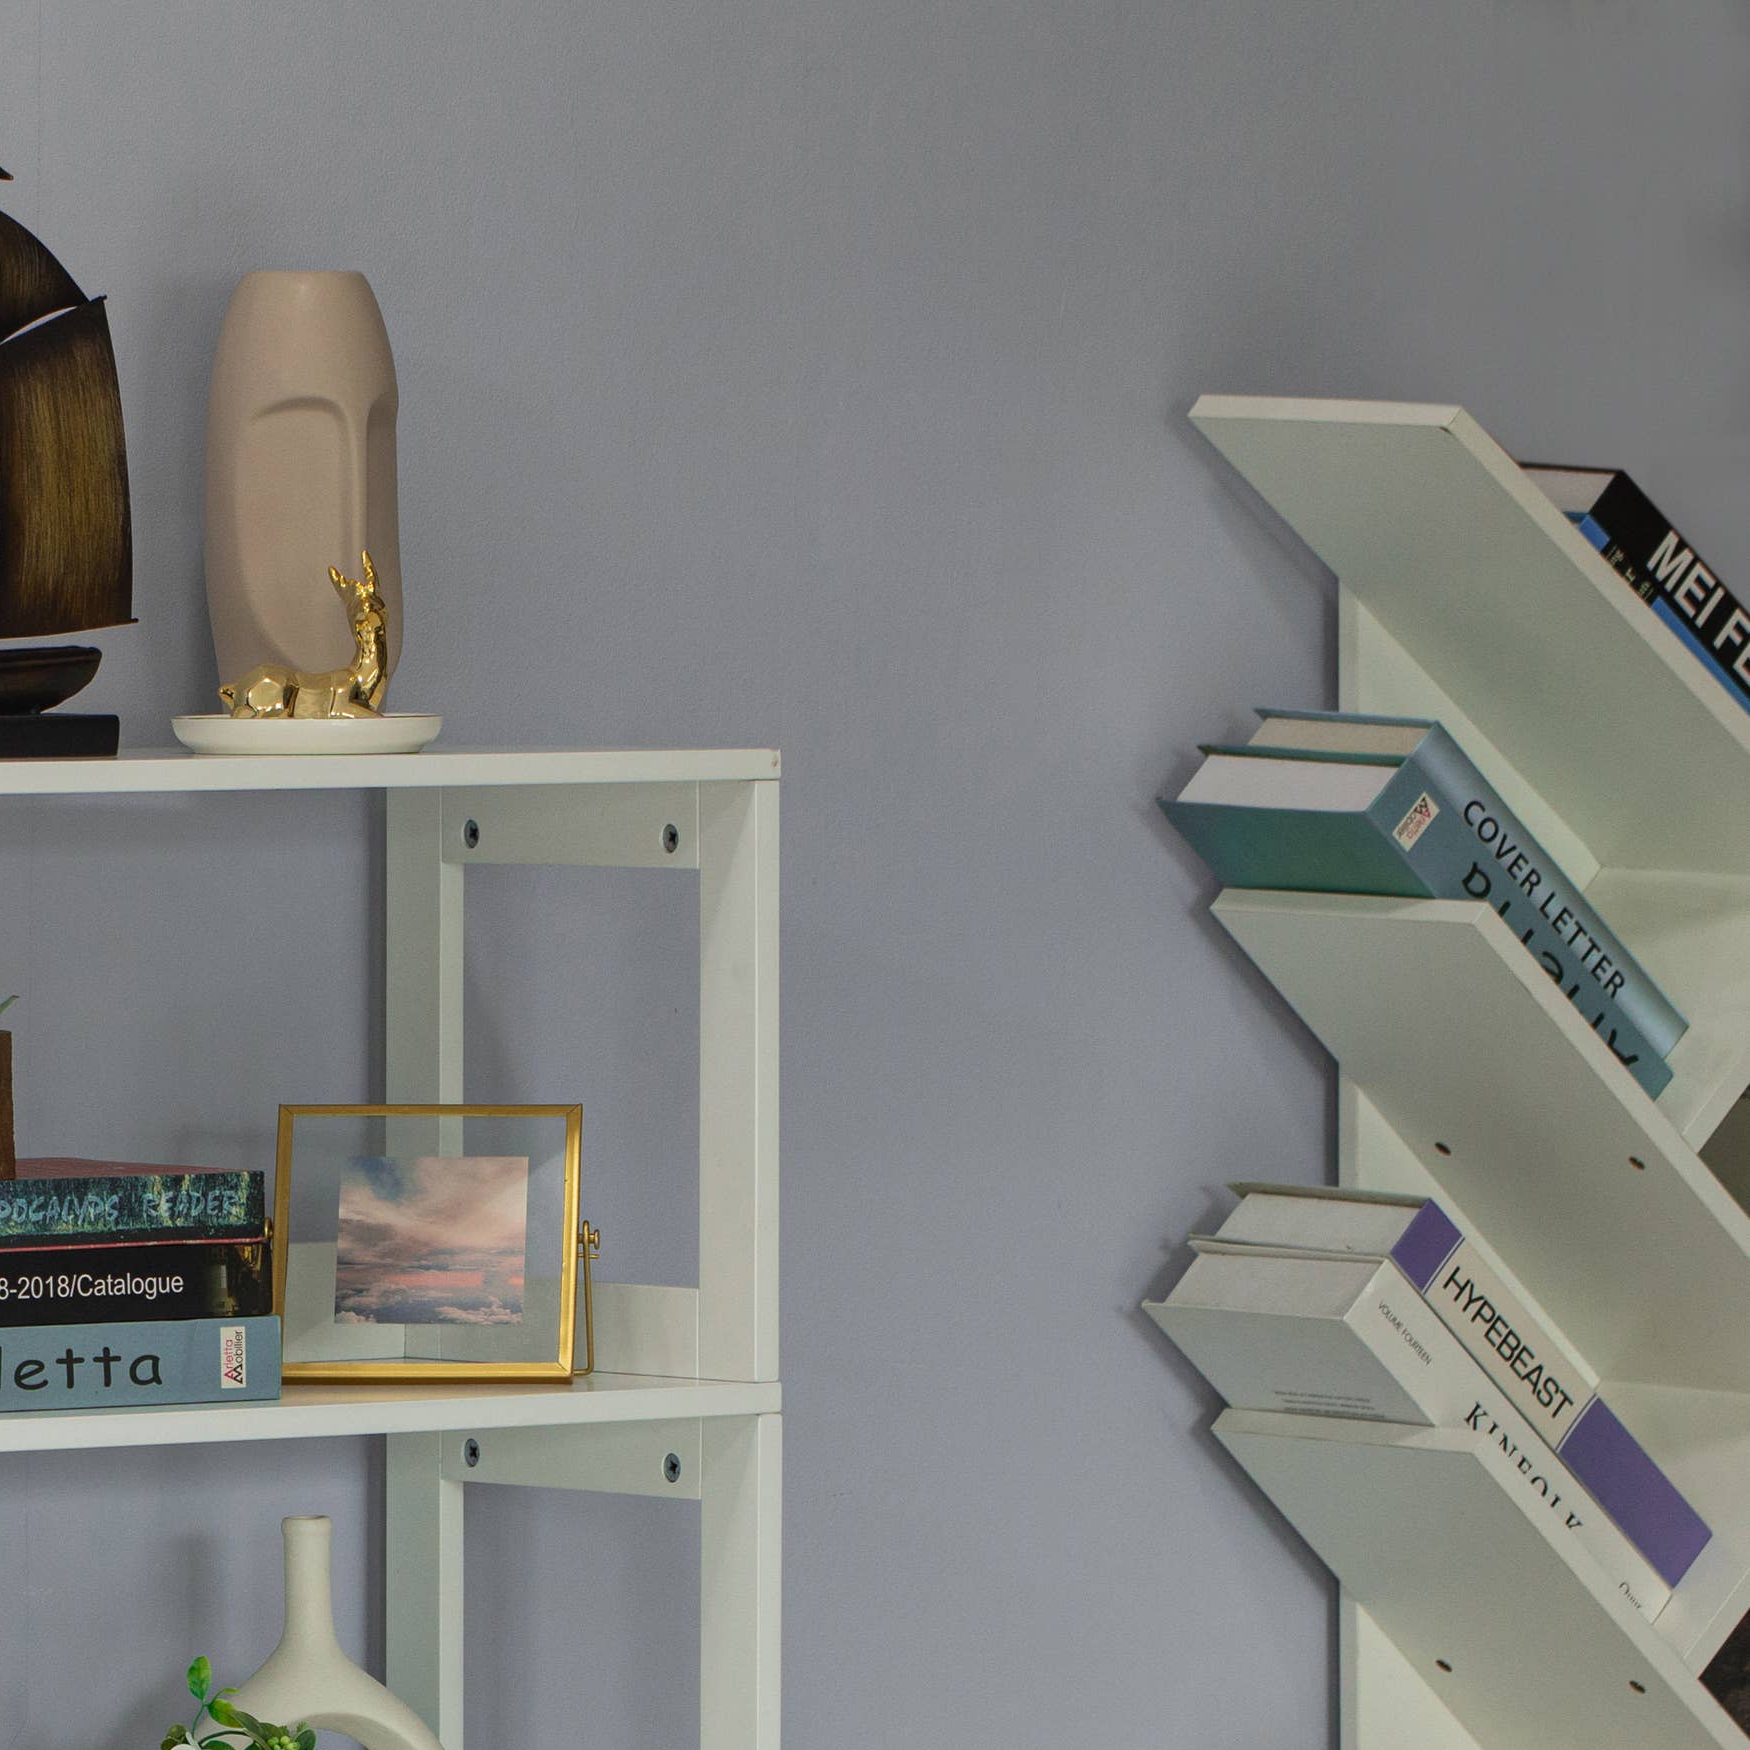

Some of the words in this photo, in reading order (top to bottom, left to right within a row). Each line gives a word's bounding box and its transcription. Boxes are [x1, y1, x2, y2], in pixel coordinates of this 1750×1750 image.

[1646, 529, 1725, 629] MEI
[1463, 800, 1542, 897] COVER
[1539, 892, 1625, 999] LETTER
[1443, 1266, 1574, 1419] HYPEBEAST
